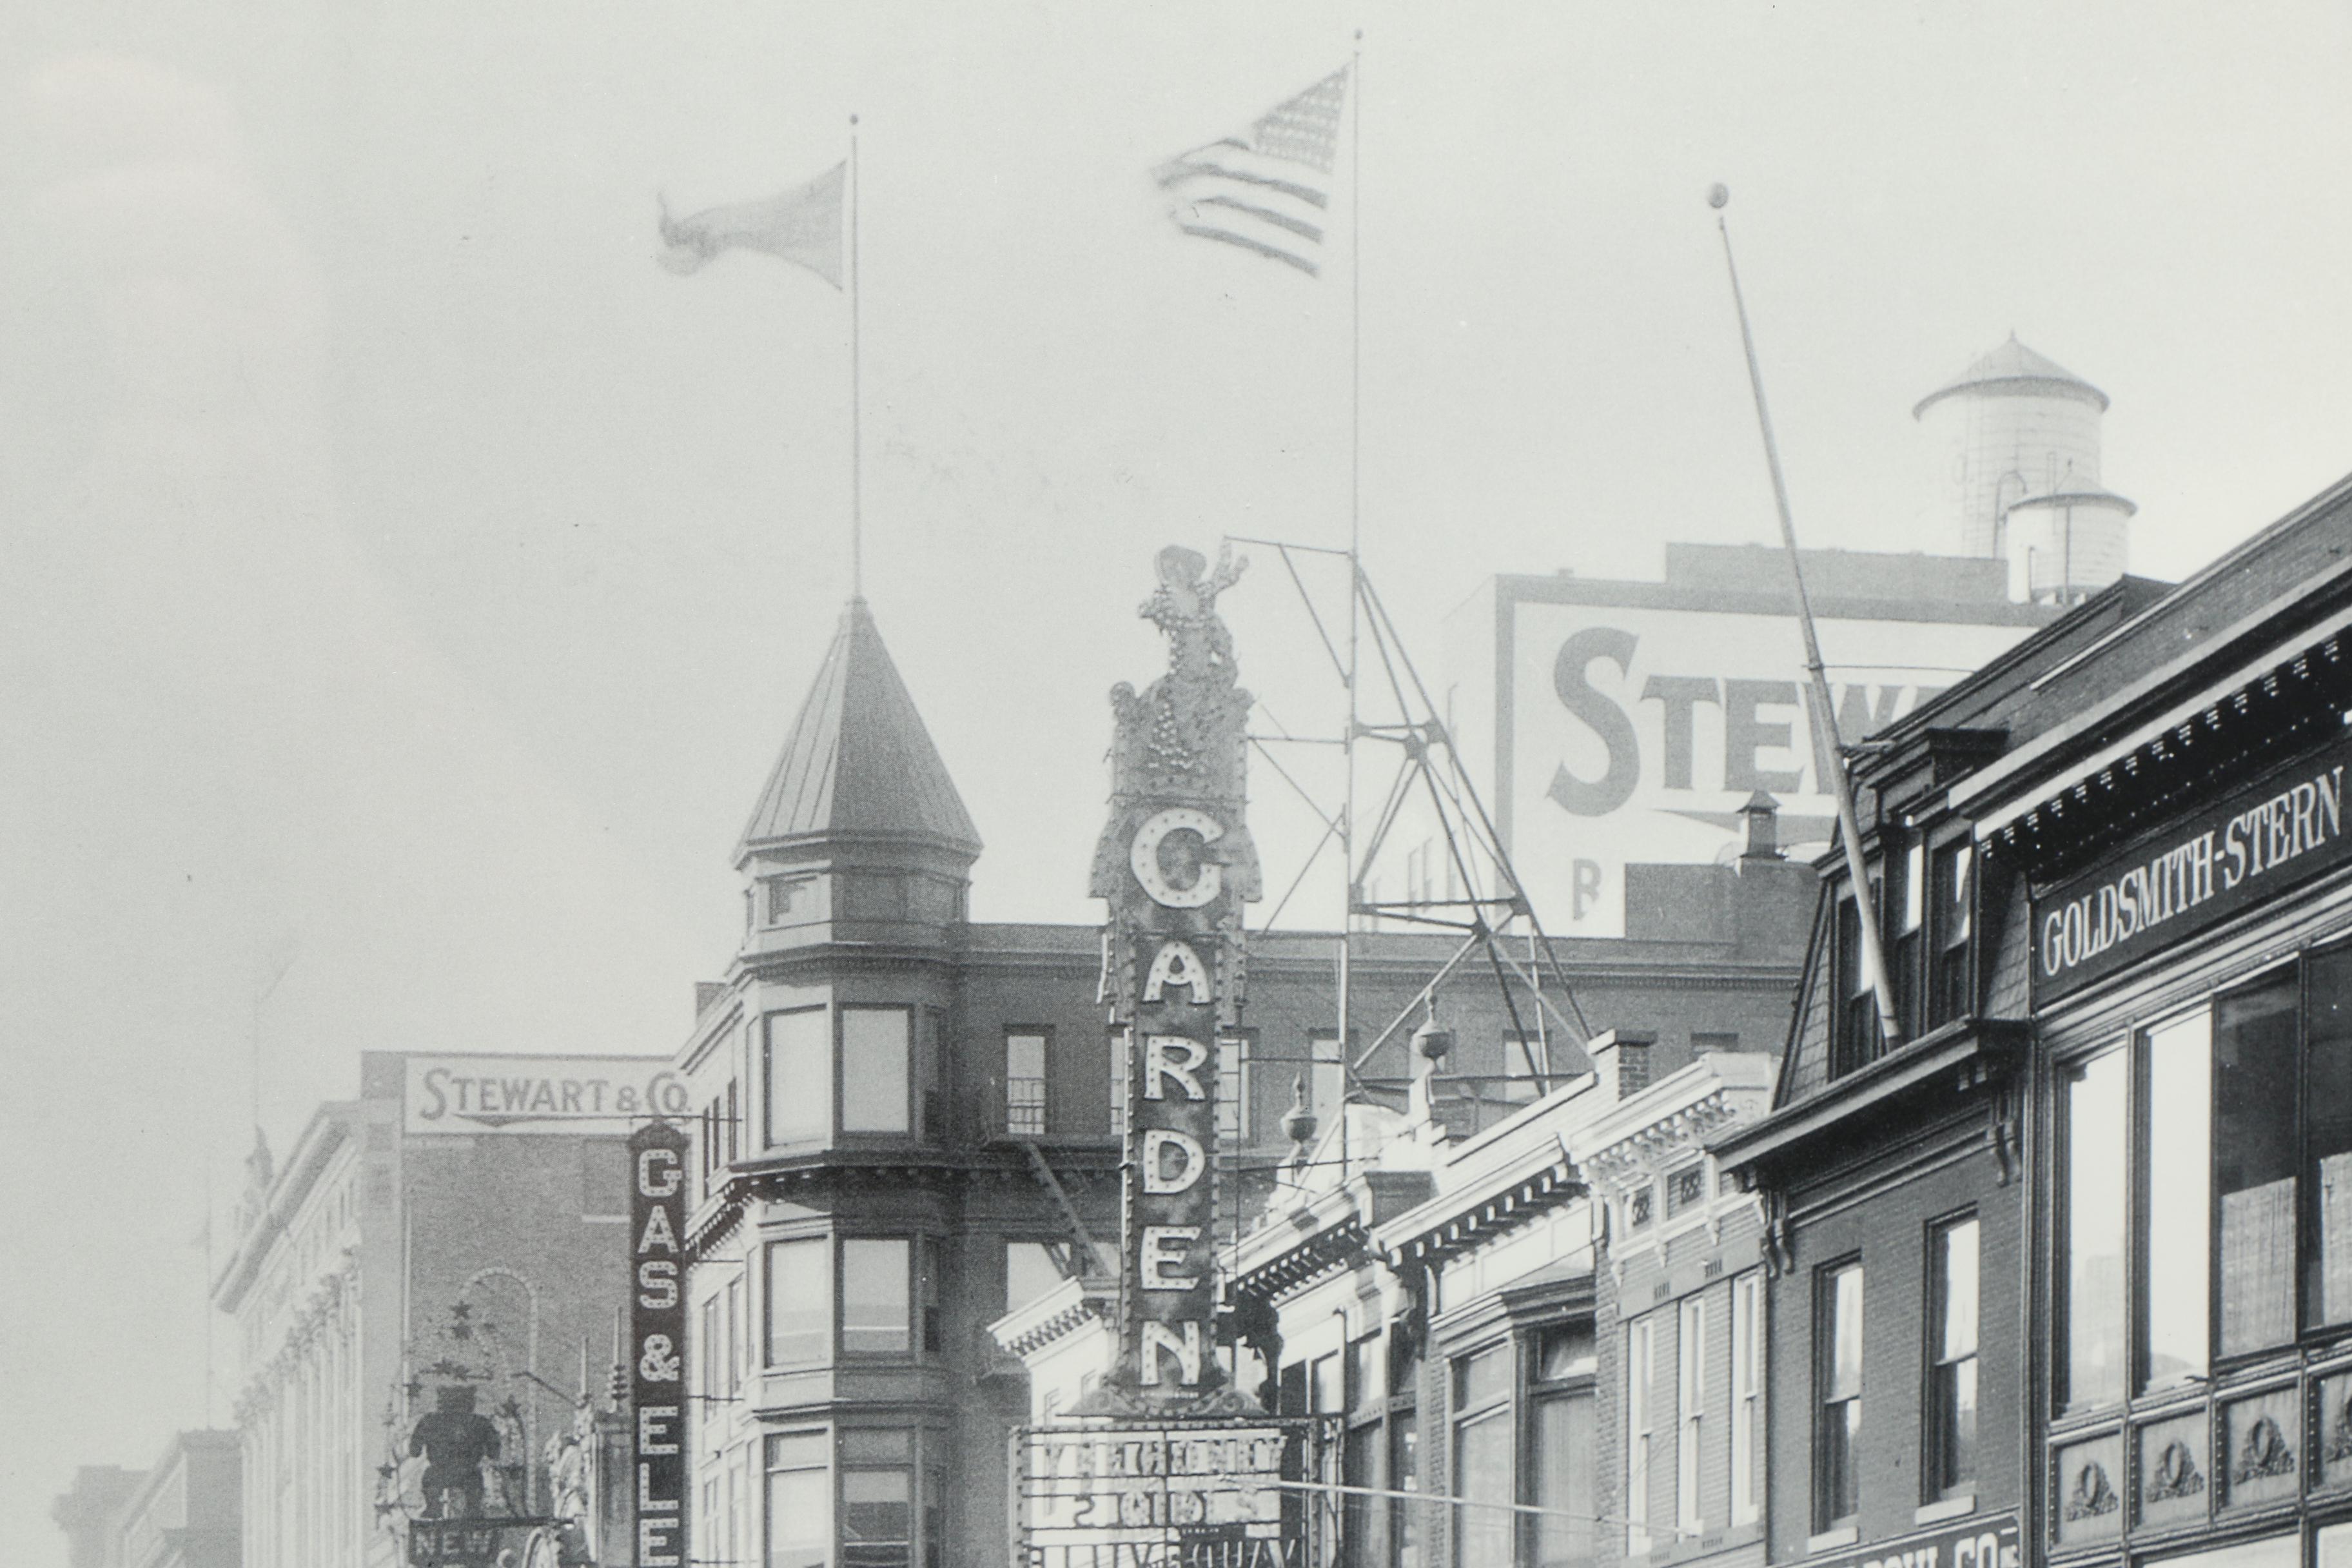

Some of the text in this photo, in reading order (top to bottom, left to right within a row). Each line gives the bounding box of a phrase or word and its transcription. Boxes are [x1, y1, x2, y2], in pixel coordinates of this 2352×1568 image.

[2043, 765, 2344, 976] GOLDSMITH-STERN
[420, 1067, 609, 1121] STEWART
[615, 1085, 642, 1113] &
[639, 1148, 683, 1567] GAS & ELE
